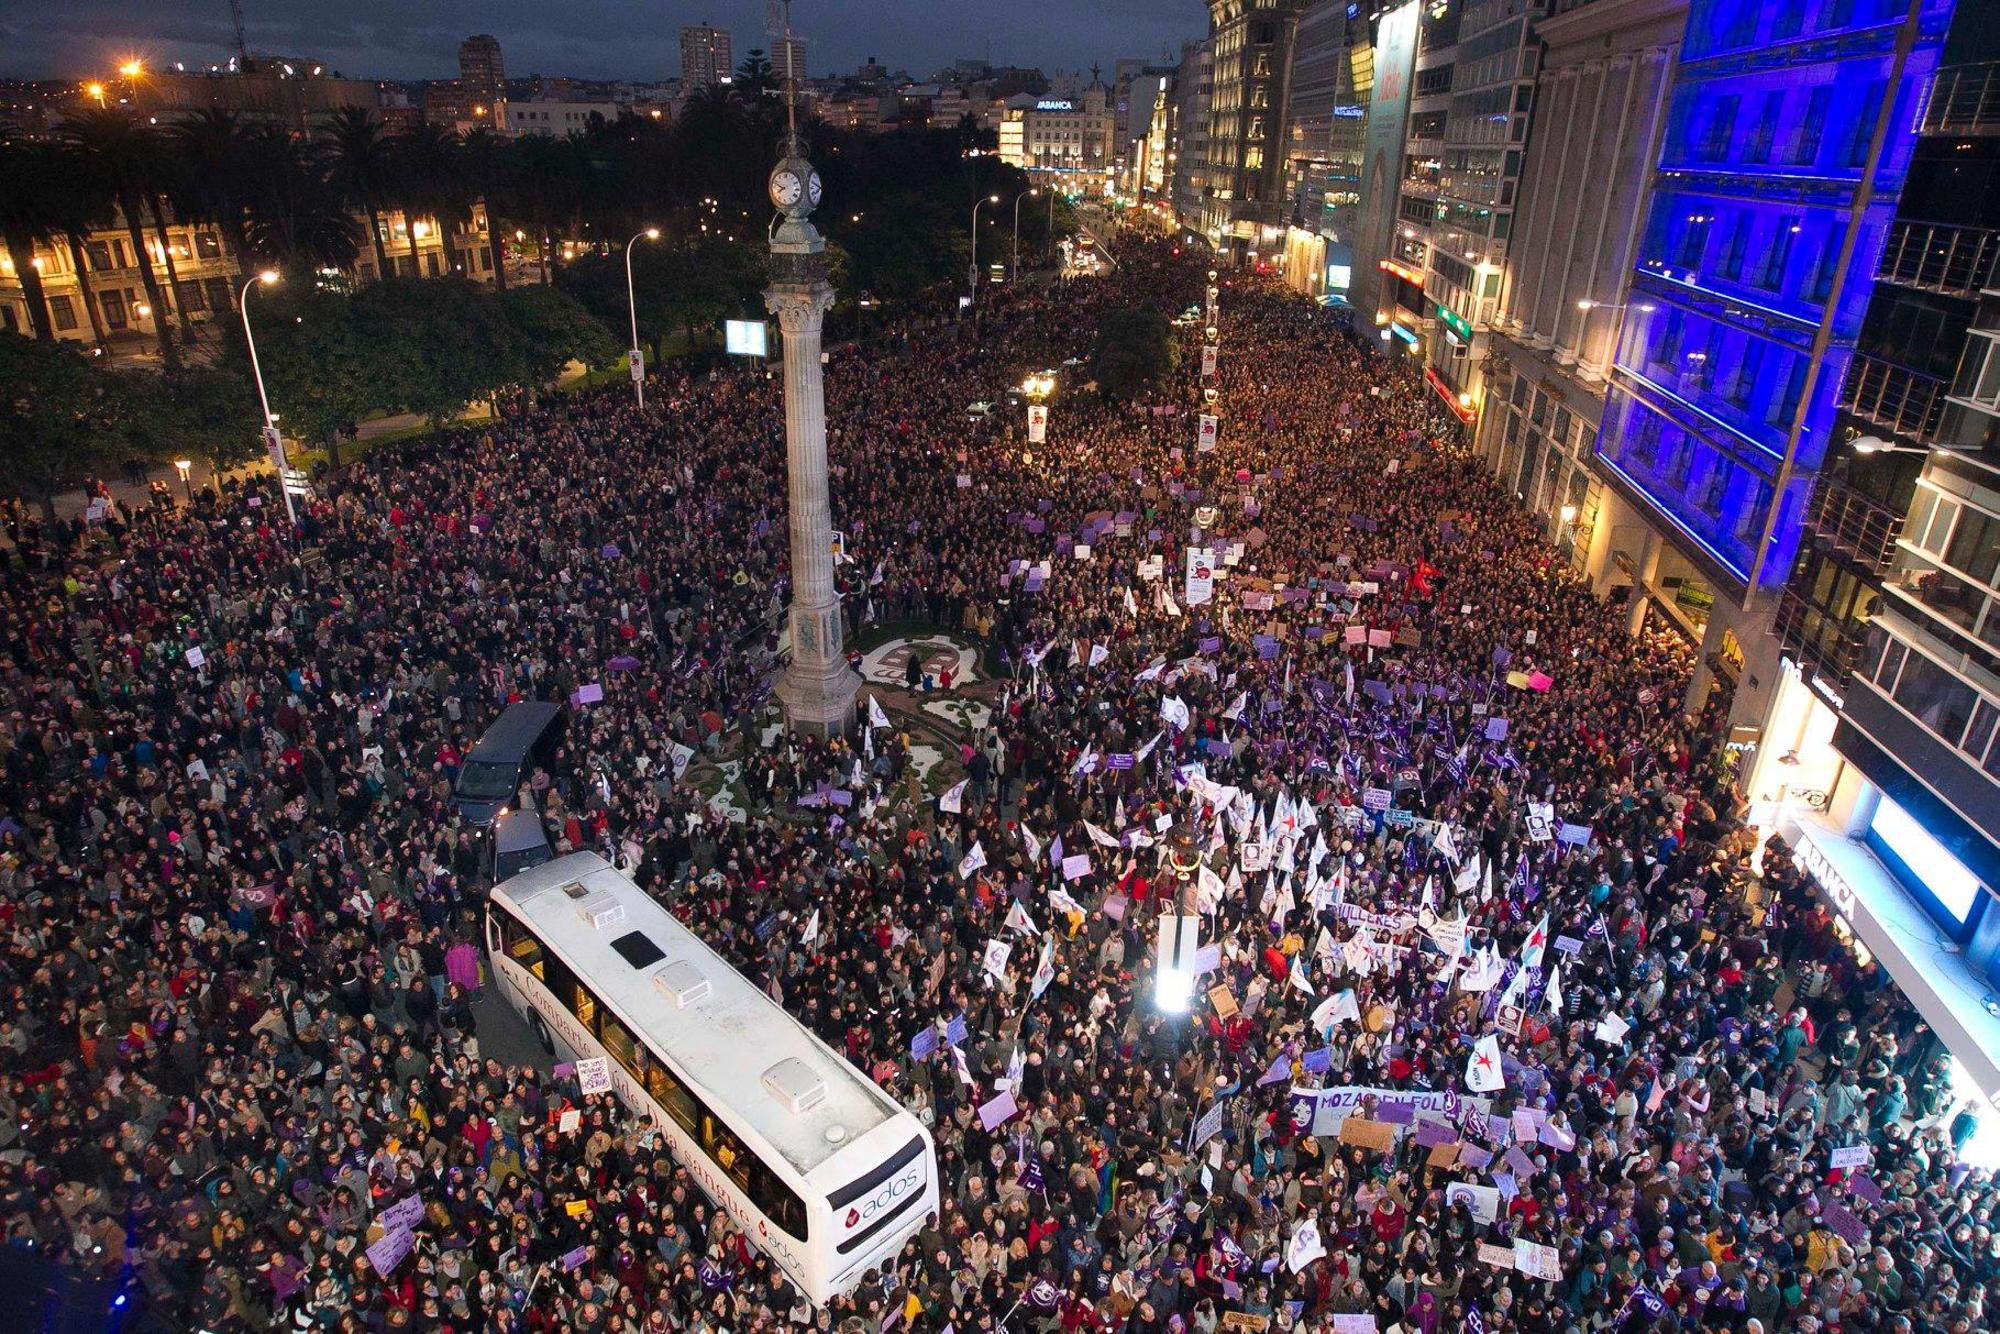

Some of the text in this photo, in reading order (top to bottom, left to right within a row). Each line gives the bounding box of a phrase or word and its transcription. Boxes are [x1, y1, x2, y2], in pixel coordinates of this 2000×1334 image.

[1037, 101, 1072, 109] ABANCA
[1792, 834, 1856, 922] ABANCA
[526, 976, 591, 1056] Comparte
[863, 1168, 918, 1219] ados
[768, 1232, 806, 1278] ados
